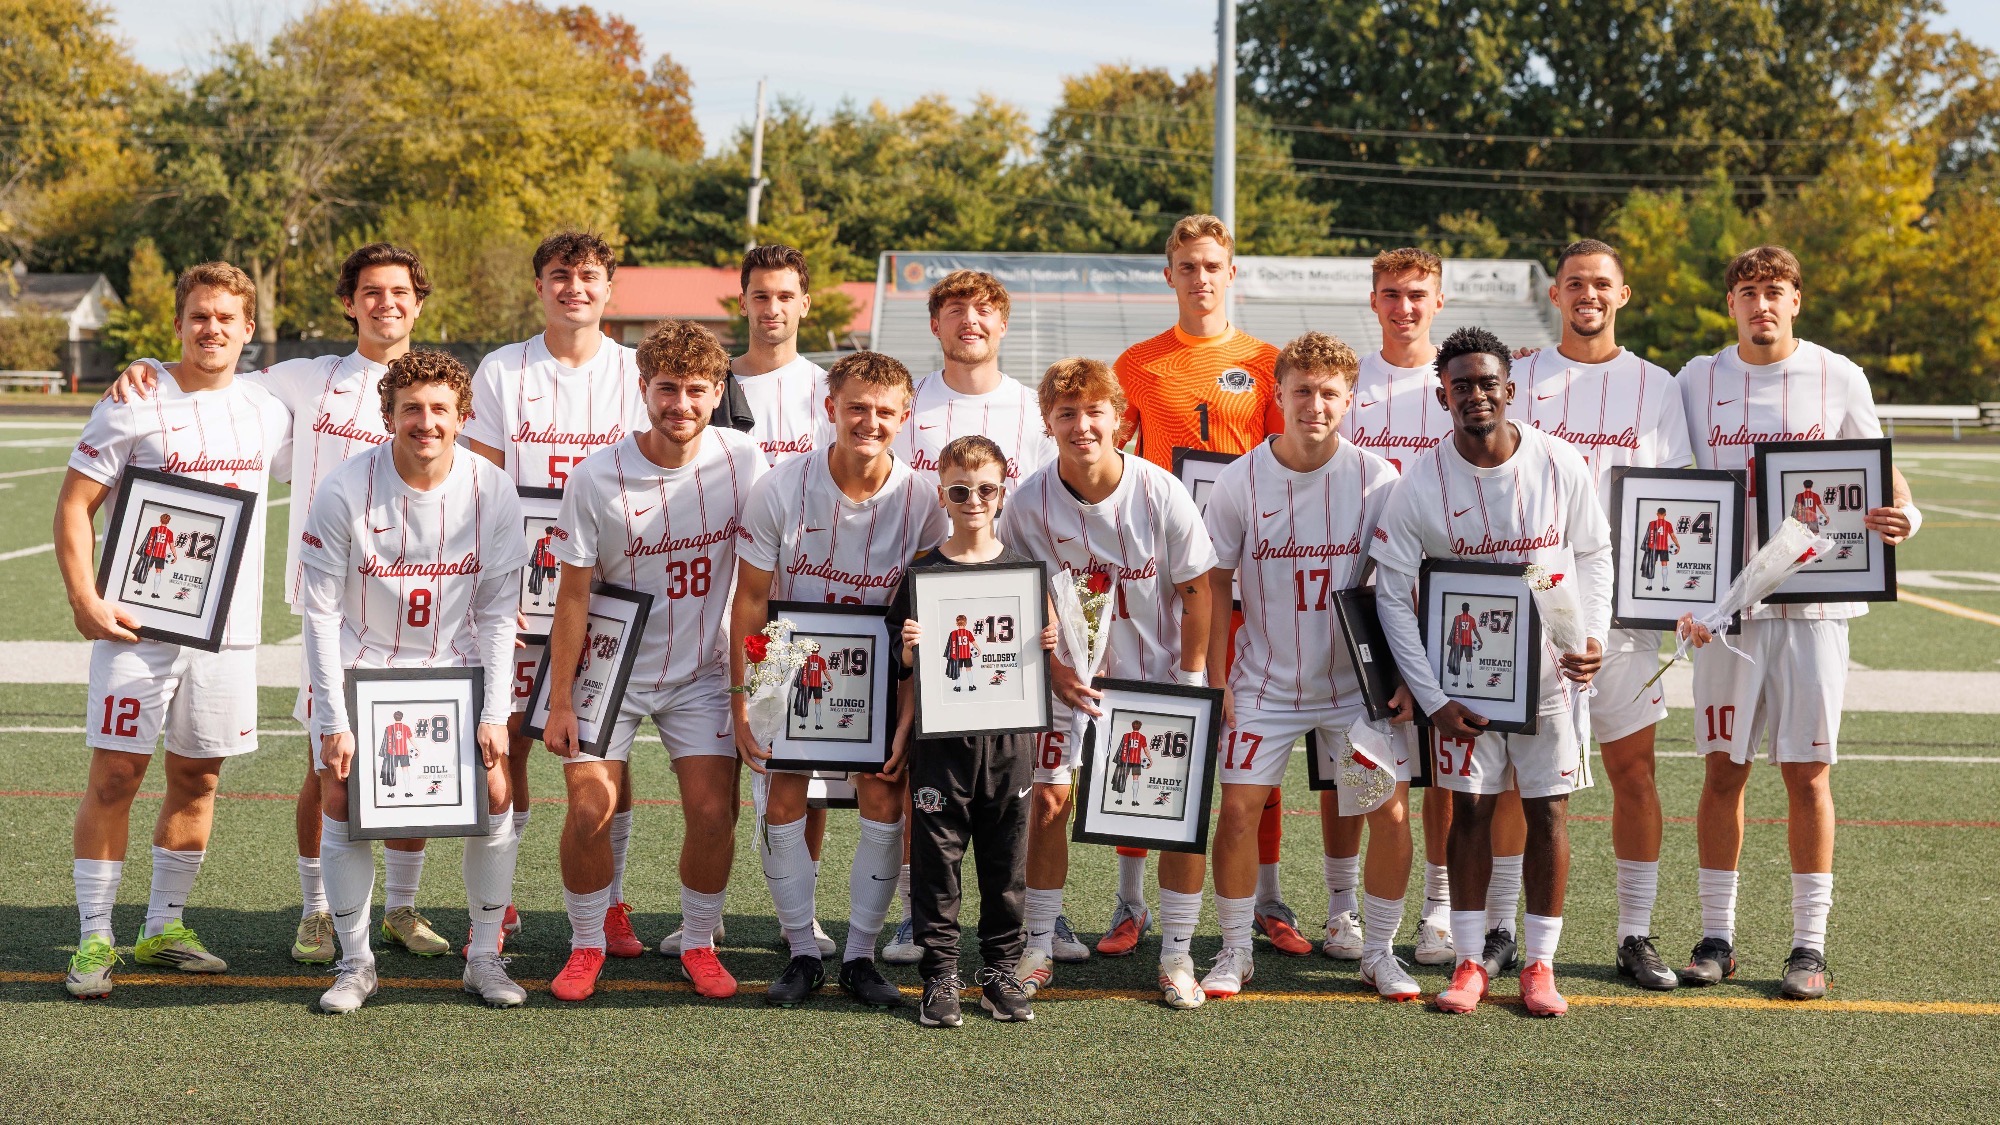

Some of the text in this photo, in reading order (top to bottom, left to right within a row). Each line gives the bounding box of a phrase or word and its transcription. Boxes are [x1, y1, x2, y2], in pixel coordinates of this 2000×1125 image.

[313, 413, 393, 445] Indiana
[1194, 403, 1209, 441] 1
[1531, 420, 1641, 450] dianapolis
[160, 451, 263, 476] Indianapolis
[548, 456, 588, 489] 5
[1823, 484, 1863, 512] #10
[1450, 524, 1561, 556] Indianapolis
[1676, 512, 1713, 544] #4
[175, 531, 217, 563] #12
[1252, 533, 1361, 563] Indianapolis
[173, 572, 203, 585] HATUEL
[358, 552, 483, 582] Indianapolis
[665, 556, 711, 600] 38
[1676, 562, 1712, 570] MAYRINK
[1294, 569, 1329, 612] 17
[408, 588, 431, 628] 8
[1479, 609, 1514, 635] #57
[958, 635, 968, 646] 13
[973, 614, 1015, 643] #13
[1461, 621, 1470, 630] 57
[828, 648, 869, 677] #19
[982, 653, 1016, 663] GOLDSBY
[1479, 658, 1512, 668] MUKATO
[101, 694, 141, 738] 12
[829, 698, 865, 708] LONGO
[415, 714, 450, 744] #8
[1705, 705, 1736, 742] 10
[1150, 731, 1189, 759] #16
[1225, 730, 1264, 770] 17
[1439, 737, 1476, 777] 57
[423, 765, 448, 774] DOLL
[1148, 777, 1182, 787] HARDY
